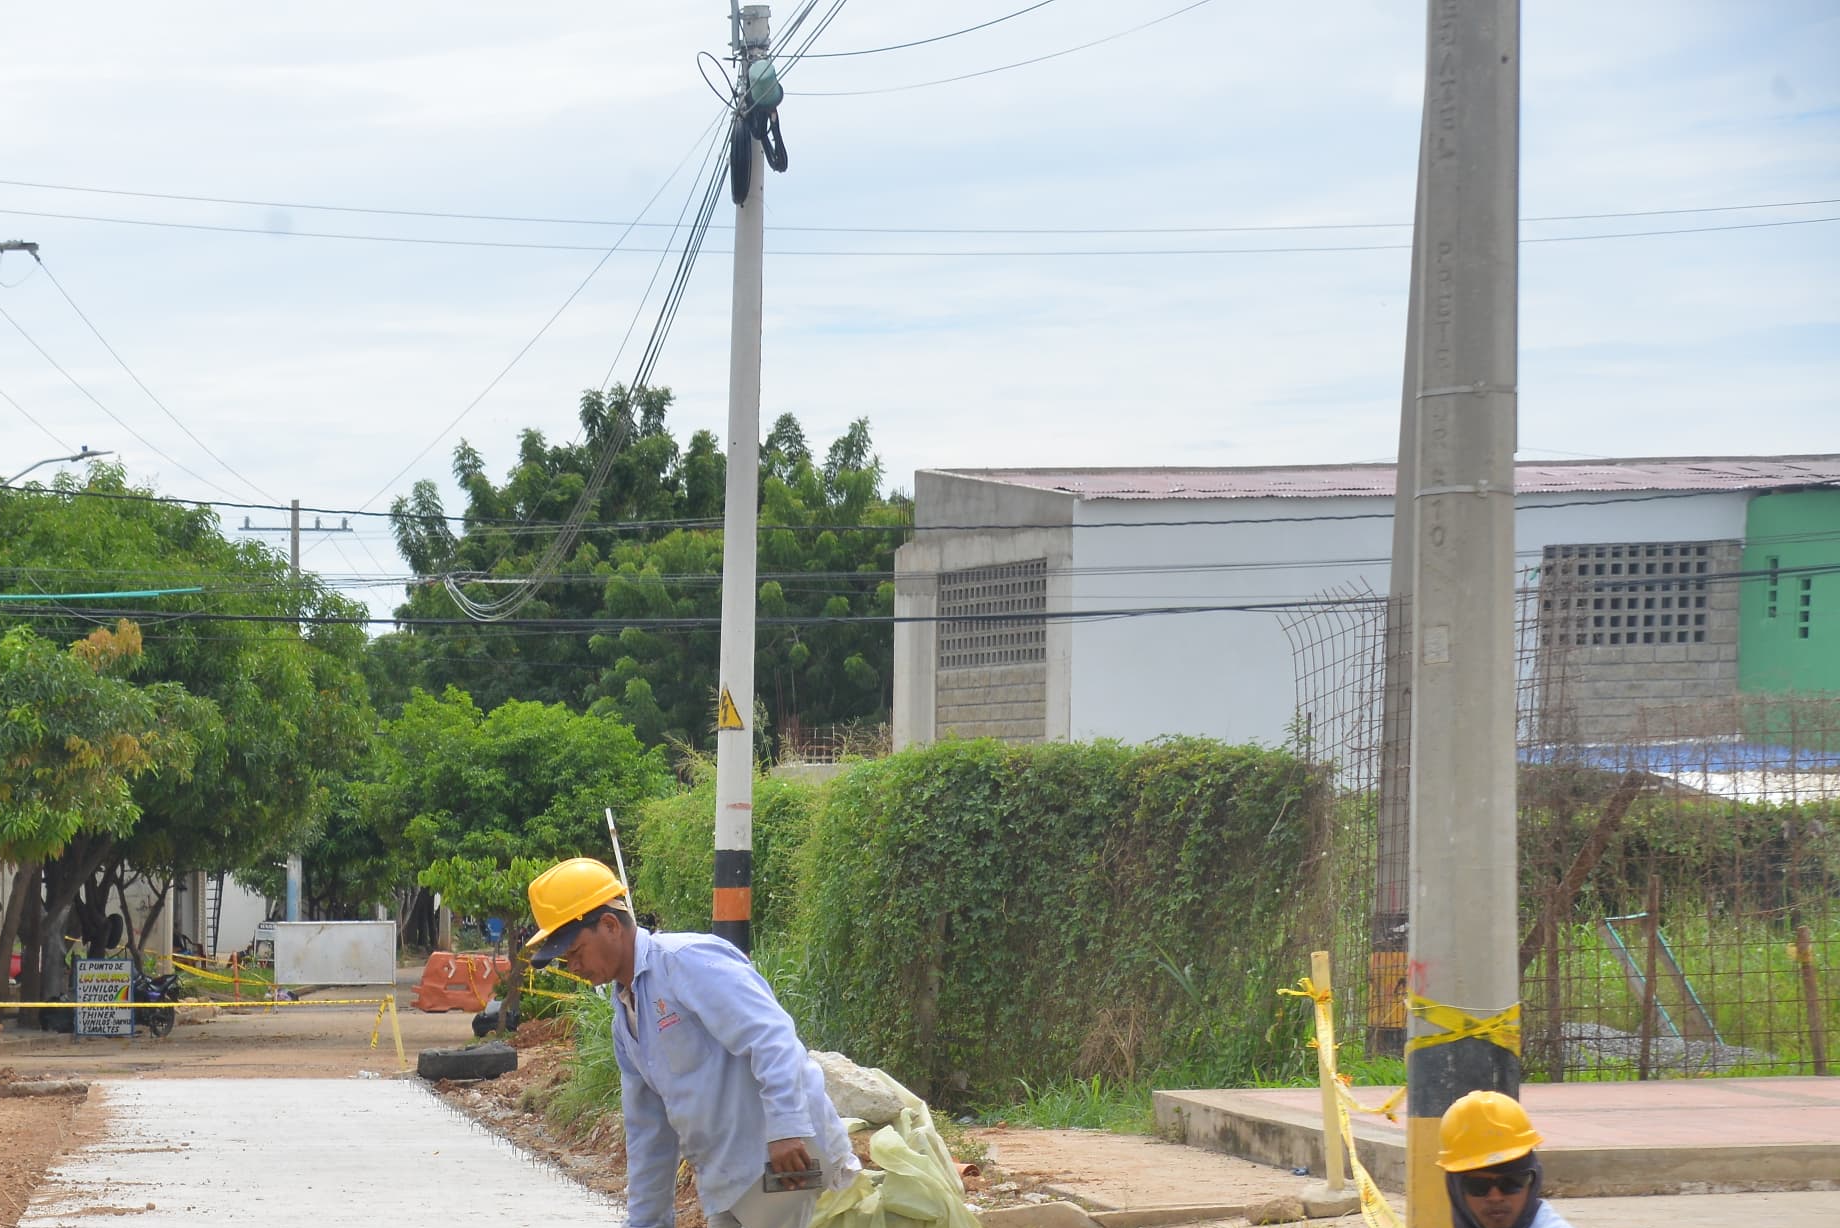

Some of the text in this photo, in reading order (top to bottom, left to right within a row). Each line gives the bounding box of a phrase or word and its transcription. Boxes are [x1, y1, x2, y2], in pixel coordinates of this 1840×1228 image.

[79, 963, 124, 971] EL PUNTO DE
[83, 993, 114, 1002] ESTUCO
[82, 1011, 116, 1019] THINER
